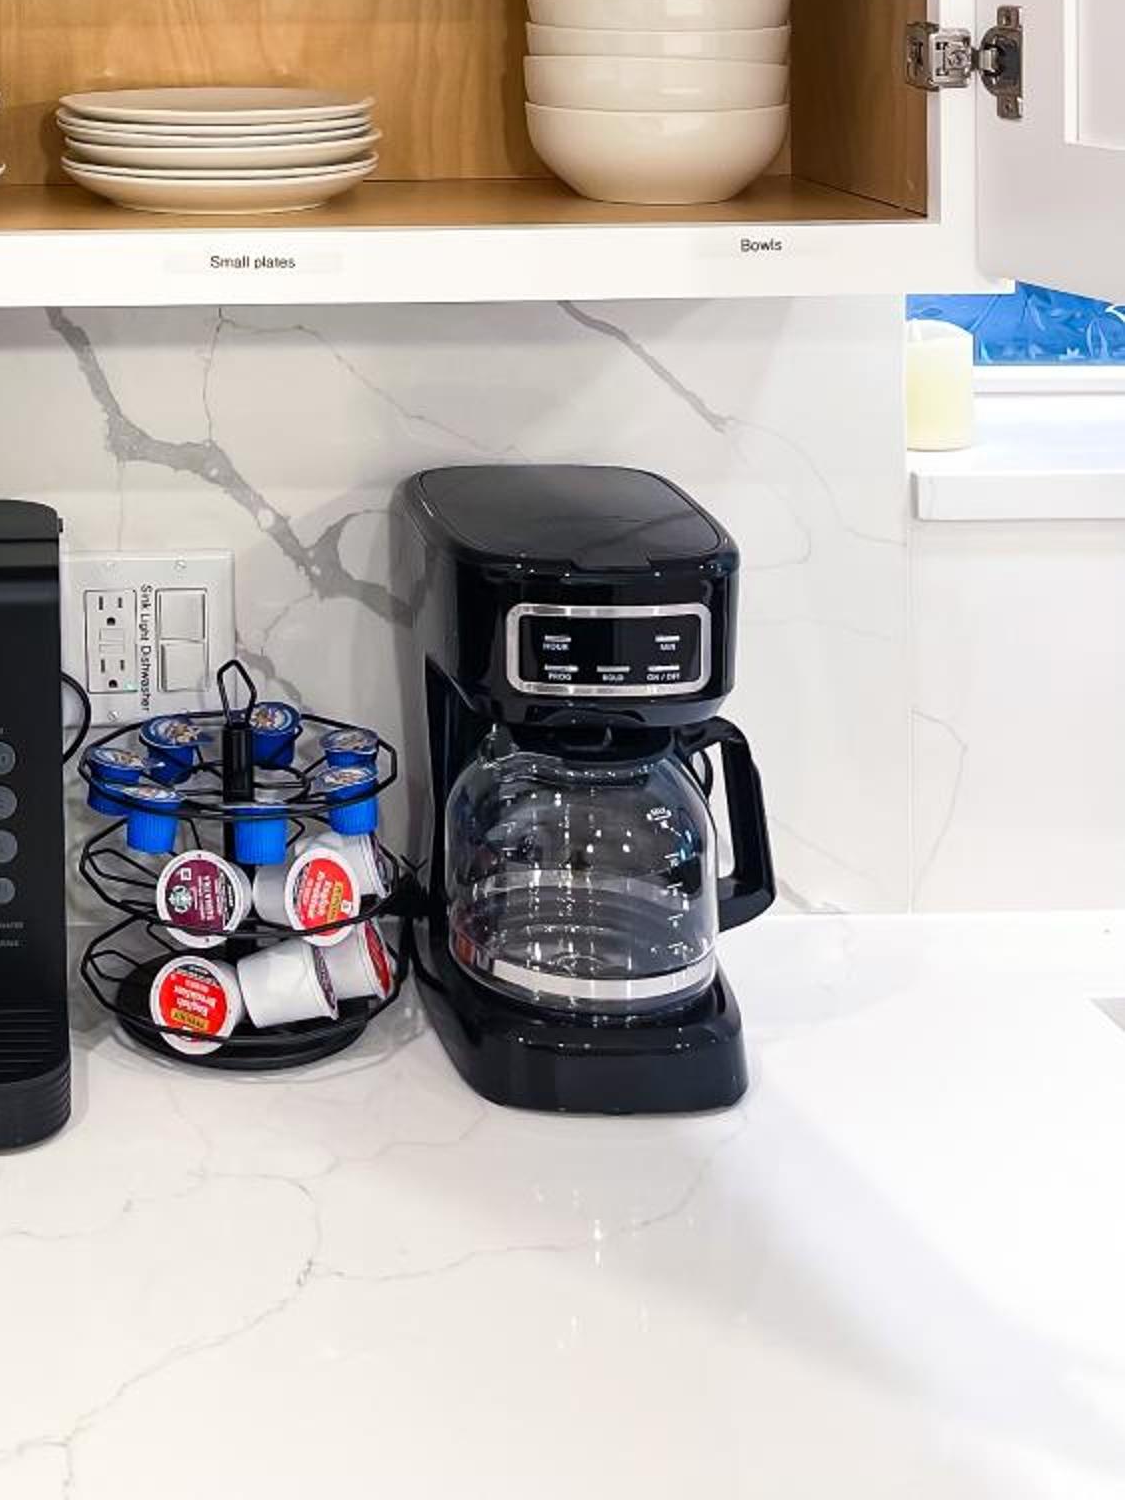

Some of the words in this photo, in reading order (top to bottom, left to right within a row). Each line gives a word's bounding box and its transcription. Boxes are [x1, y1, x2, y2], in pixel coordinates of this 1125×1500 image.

[740, 238, 782, 252] Bowls
[210, 255, 250, 269] Small
[254, 255, 296, 270] plates
[140, 584, 154, 610] Sink
[138, 613, 152, 641] Light
[140, 645, 152, 712] Dishwasher
